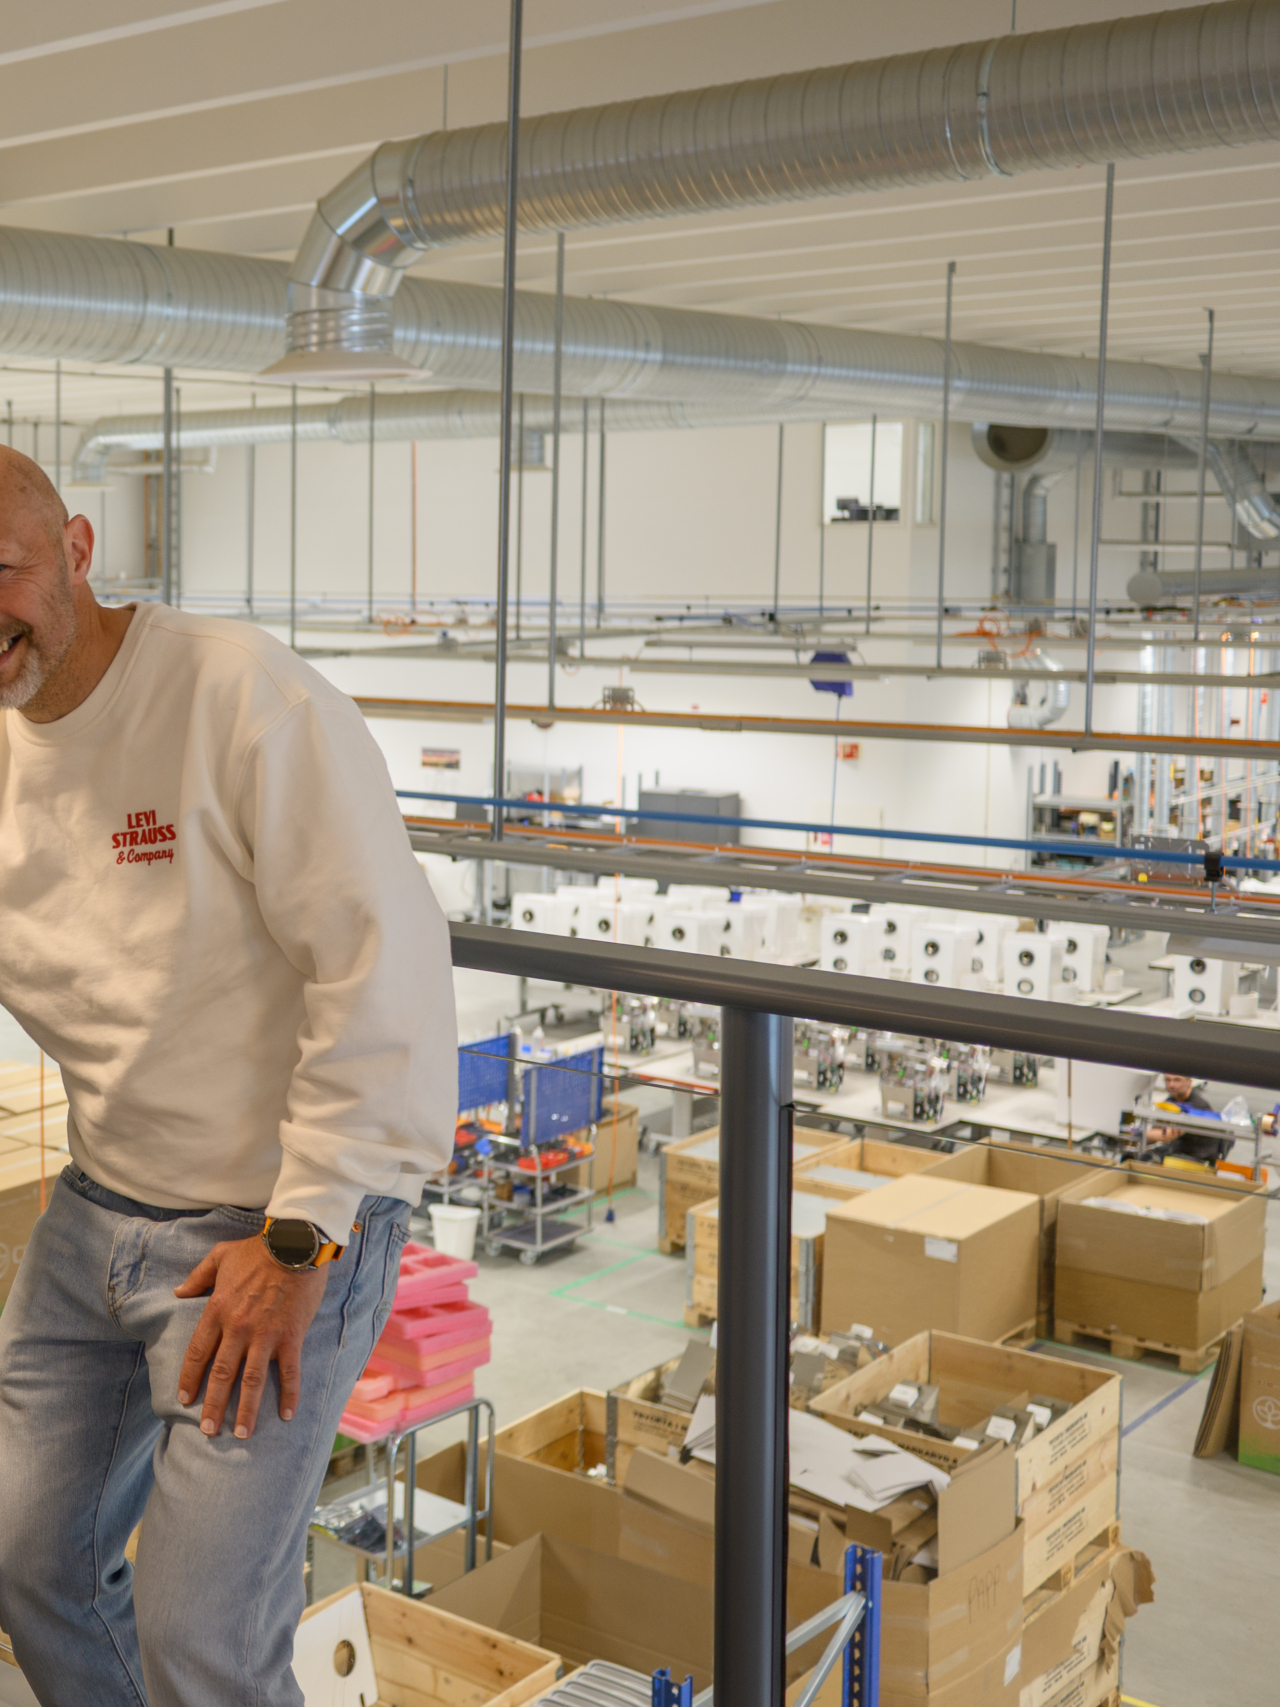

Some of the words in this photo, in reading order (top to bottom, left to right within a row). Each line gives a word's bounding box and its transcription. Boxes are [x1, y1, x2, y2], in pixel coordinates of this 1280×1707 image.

[127, 810, 156, 829] LEVI
[112, 824, 176, 849] STRAUSS
[116, 851, 125, 865] &
[127, 848, 174, 866] Company
[968, 1564, 1001, 1624] PAPP
